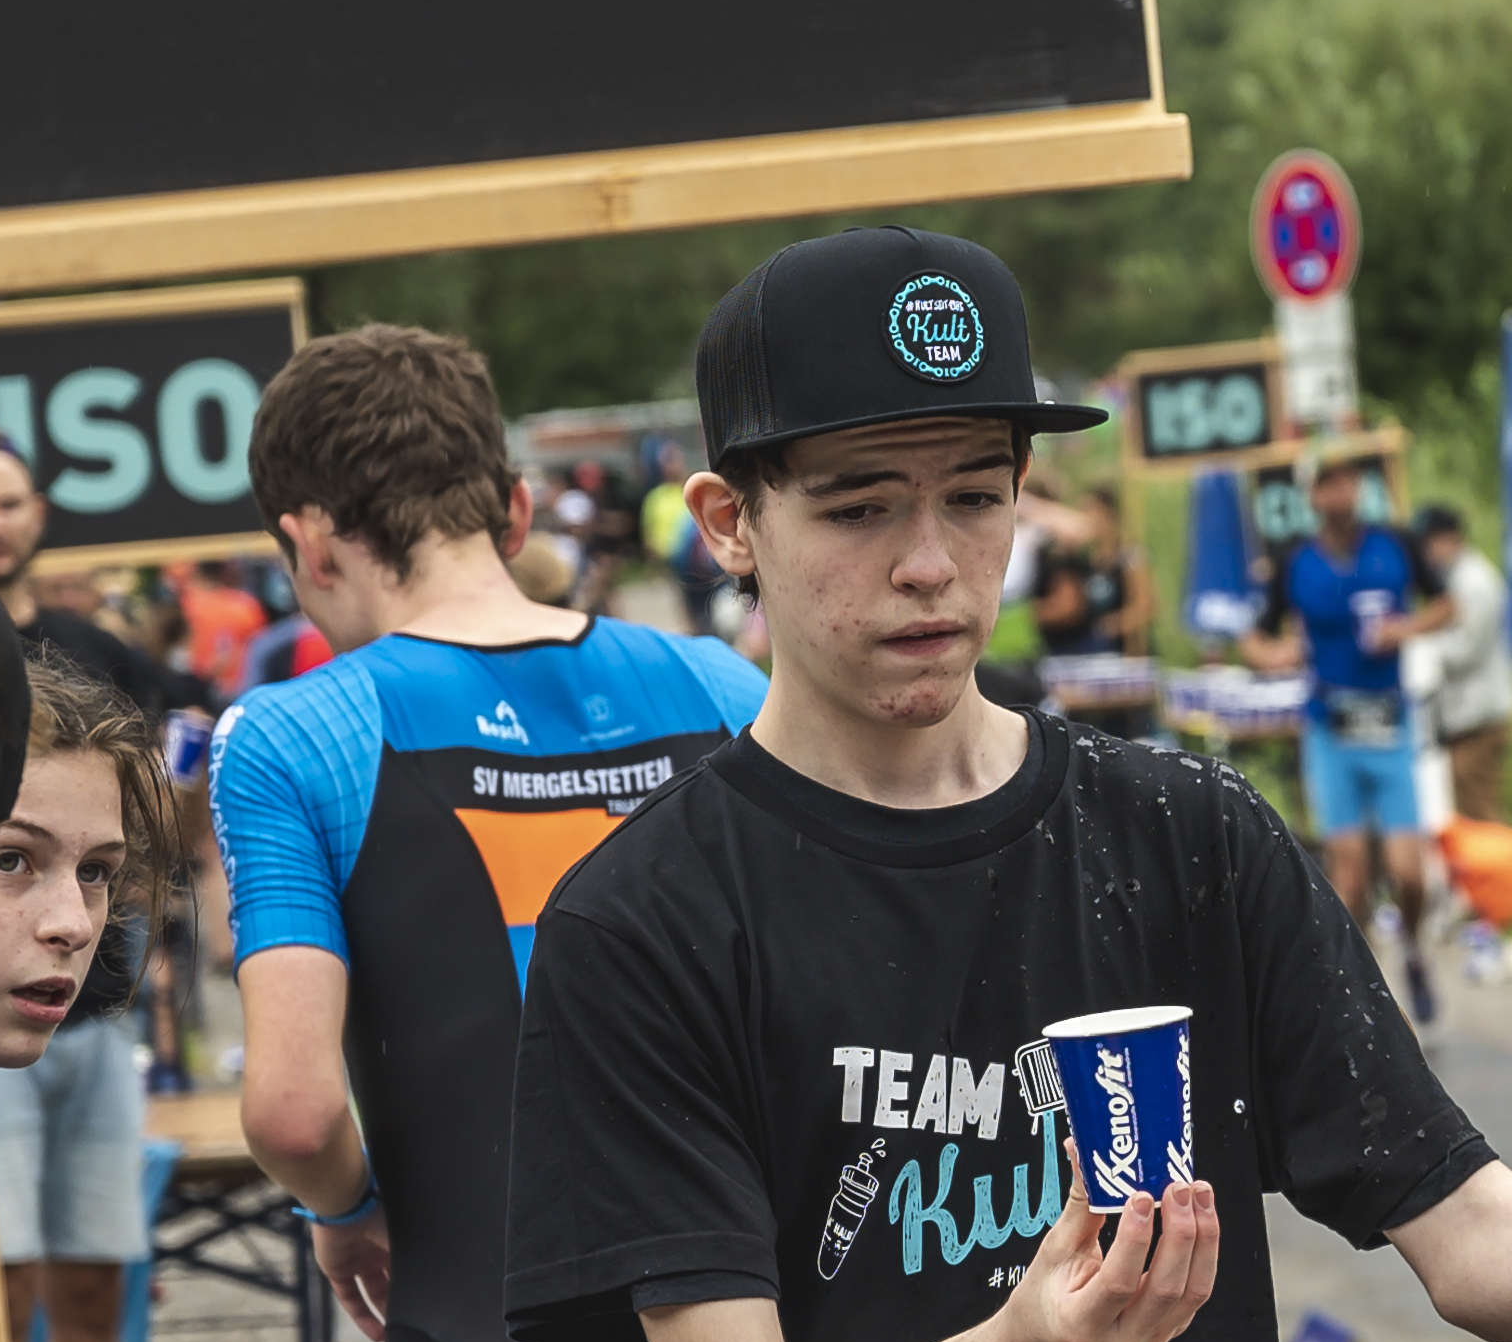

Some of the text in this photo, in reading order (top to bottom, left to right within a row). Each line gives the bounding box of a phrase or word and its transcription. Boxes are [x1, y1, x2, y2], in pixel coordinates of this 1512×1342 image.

[907, 313, 970, 343] Kult
[925, 345, 961, 361] TEAM
[1148, 373, 1266, 453] ISO
[473, 756, 674, 799] SV MERGELSTETTEN
[833, 1047, 1005, 1140] TEAM
[1092, 1047, 1140, 1198] Xenofit
[889, 1110, 1064, 1275] Kul
